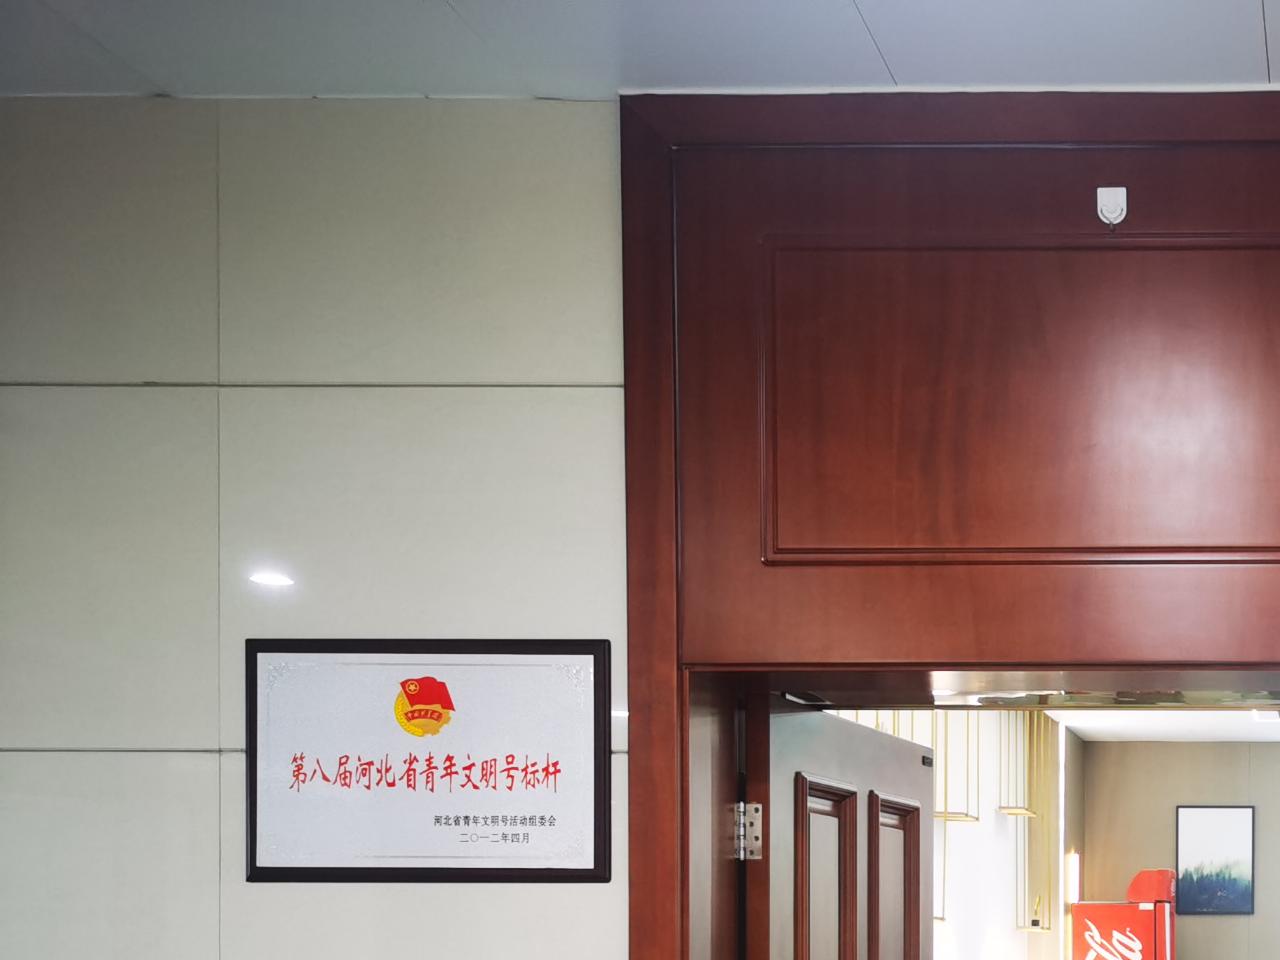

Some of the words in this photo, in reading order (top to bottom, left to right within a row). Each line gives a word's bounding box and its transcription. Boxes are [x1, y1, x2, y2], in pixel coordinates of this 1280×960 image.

[289, 752, 562, 793] 第八届河北省青年文明号标杆
[433, 815, 557, 827] 河北省青年文明号活动组委会
